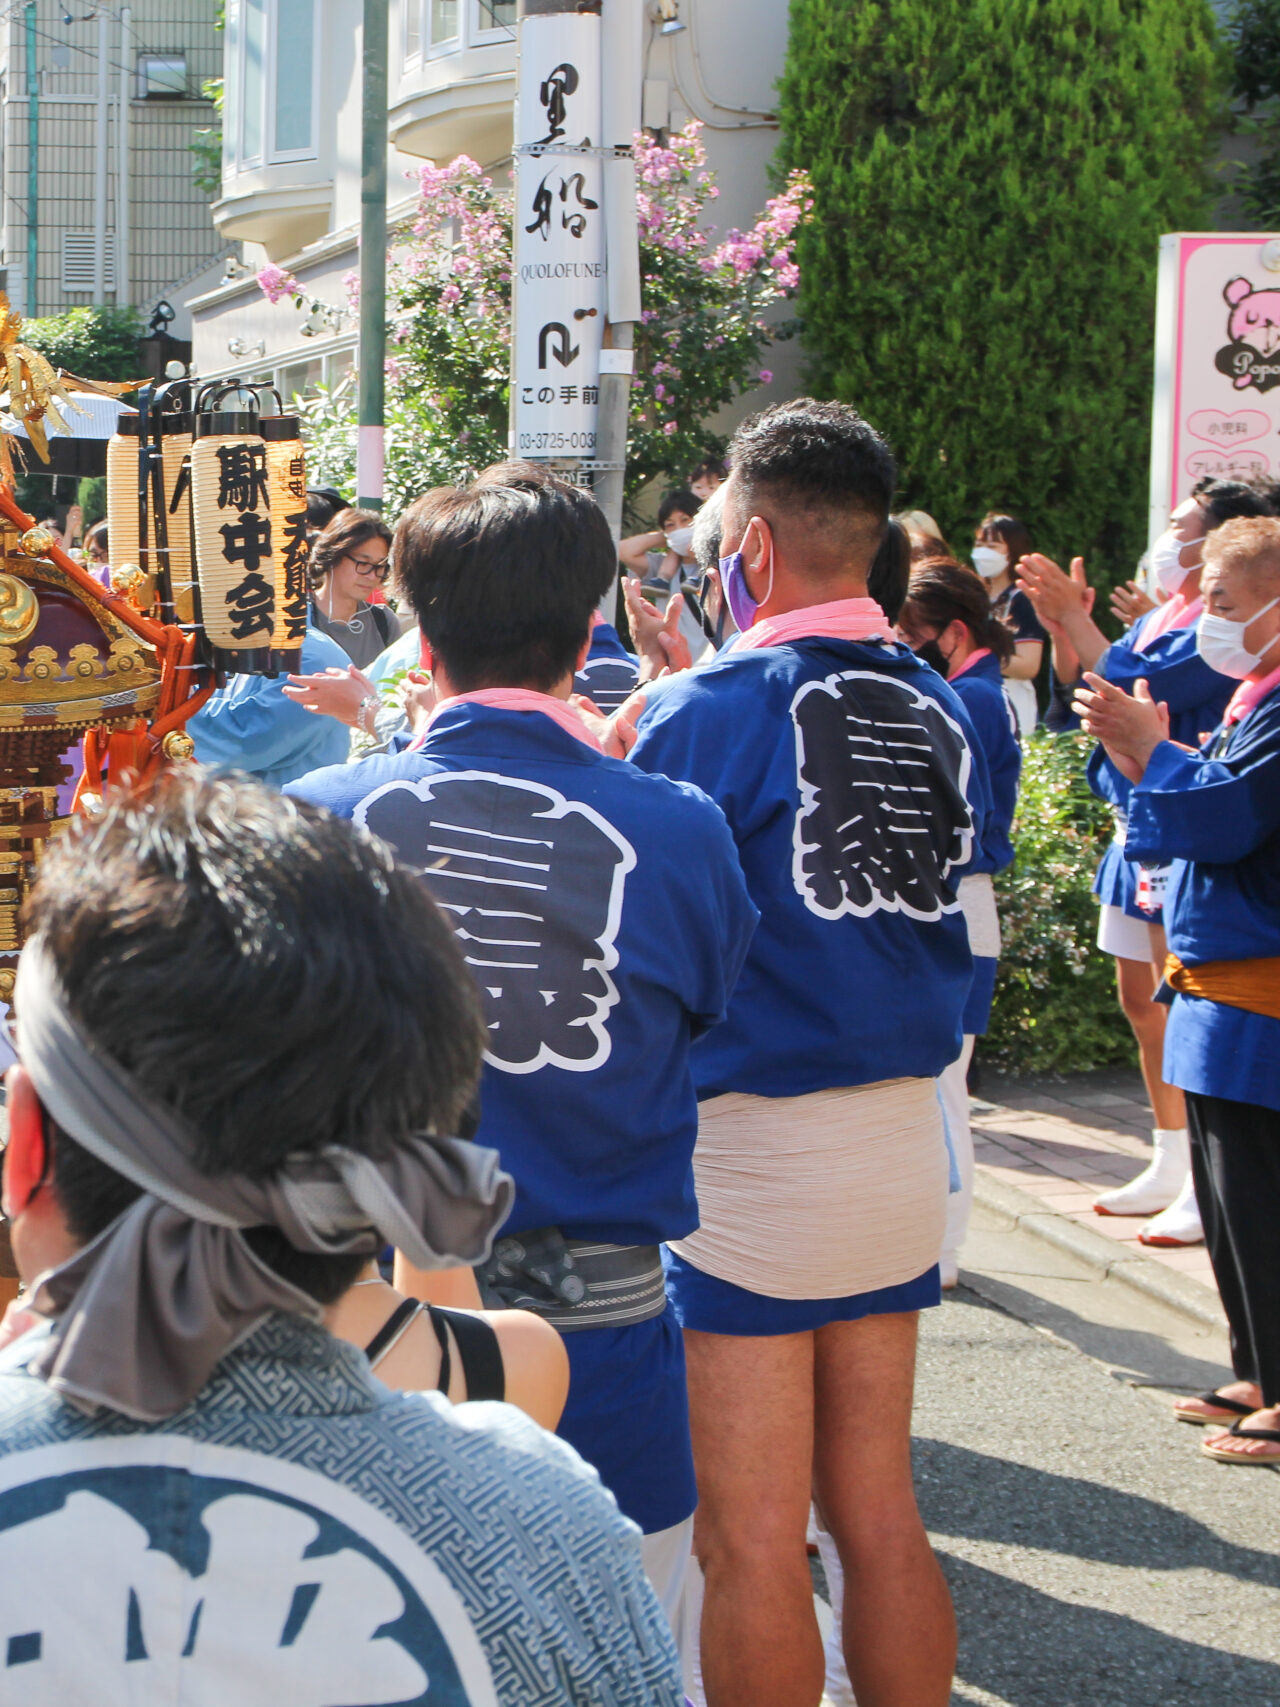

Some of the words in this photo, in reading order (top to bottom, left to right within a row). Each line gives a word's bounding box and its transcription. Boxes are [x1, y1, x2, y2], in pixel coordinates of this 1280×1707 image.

[521, 262, 601, 285] QUOLOFUNE
[522, 385, 599, 405] この手前
[1208, 422, 1248, 435] 小児科
[1193, 462, 1262, 474] アレルギー科
[216, 444, 275, 640] 駅中会
